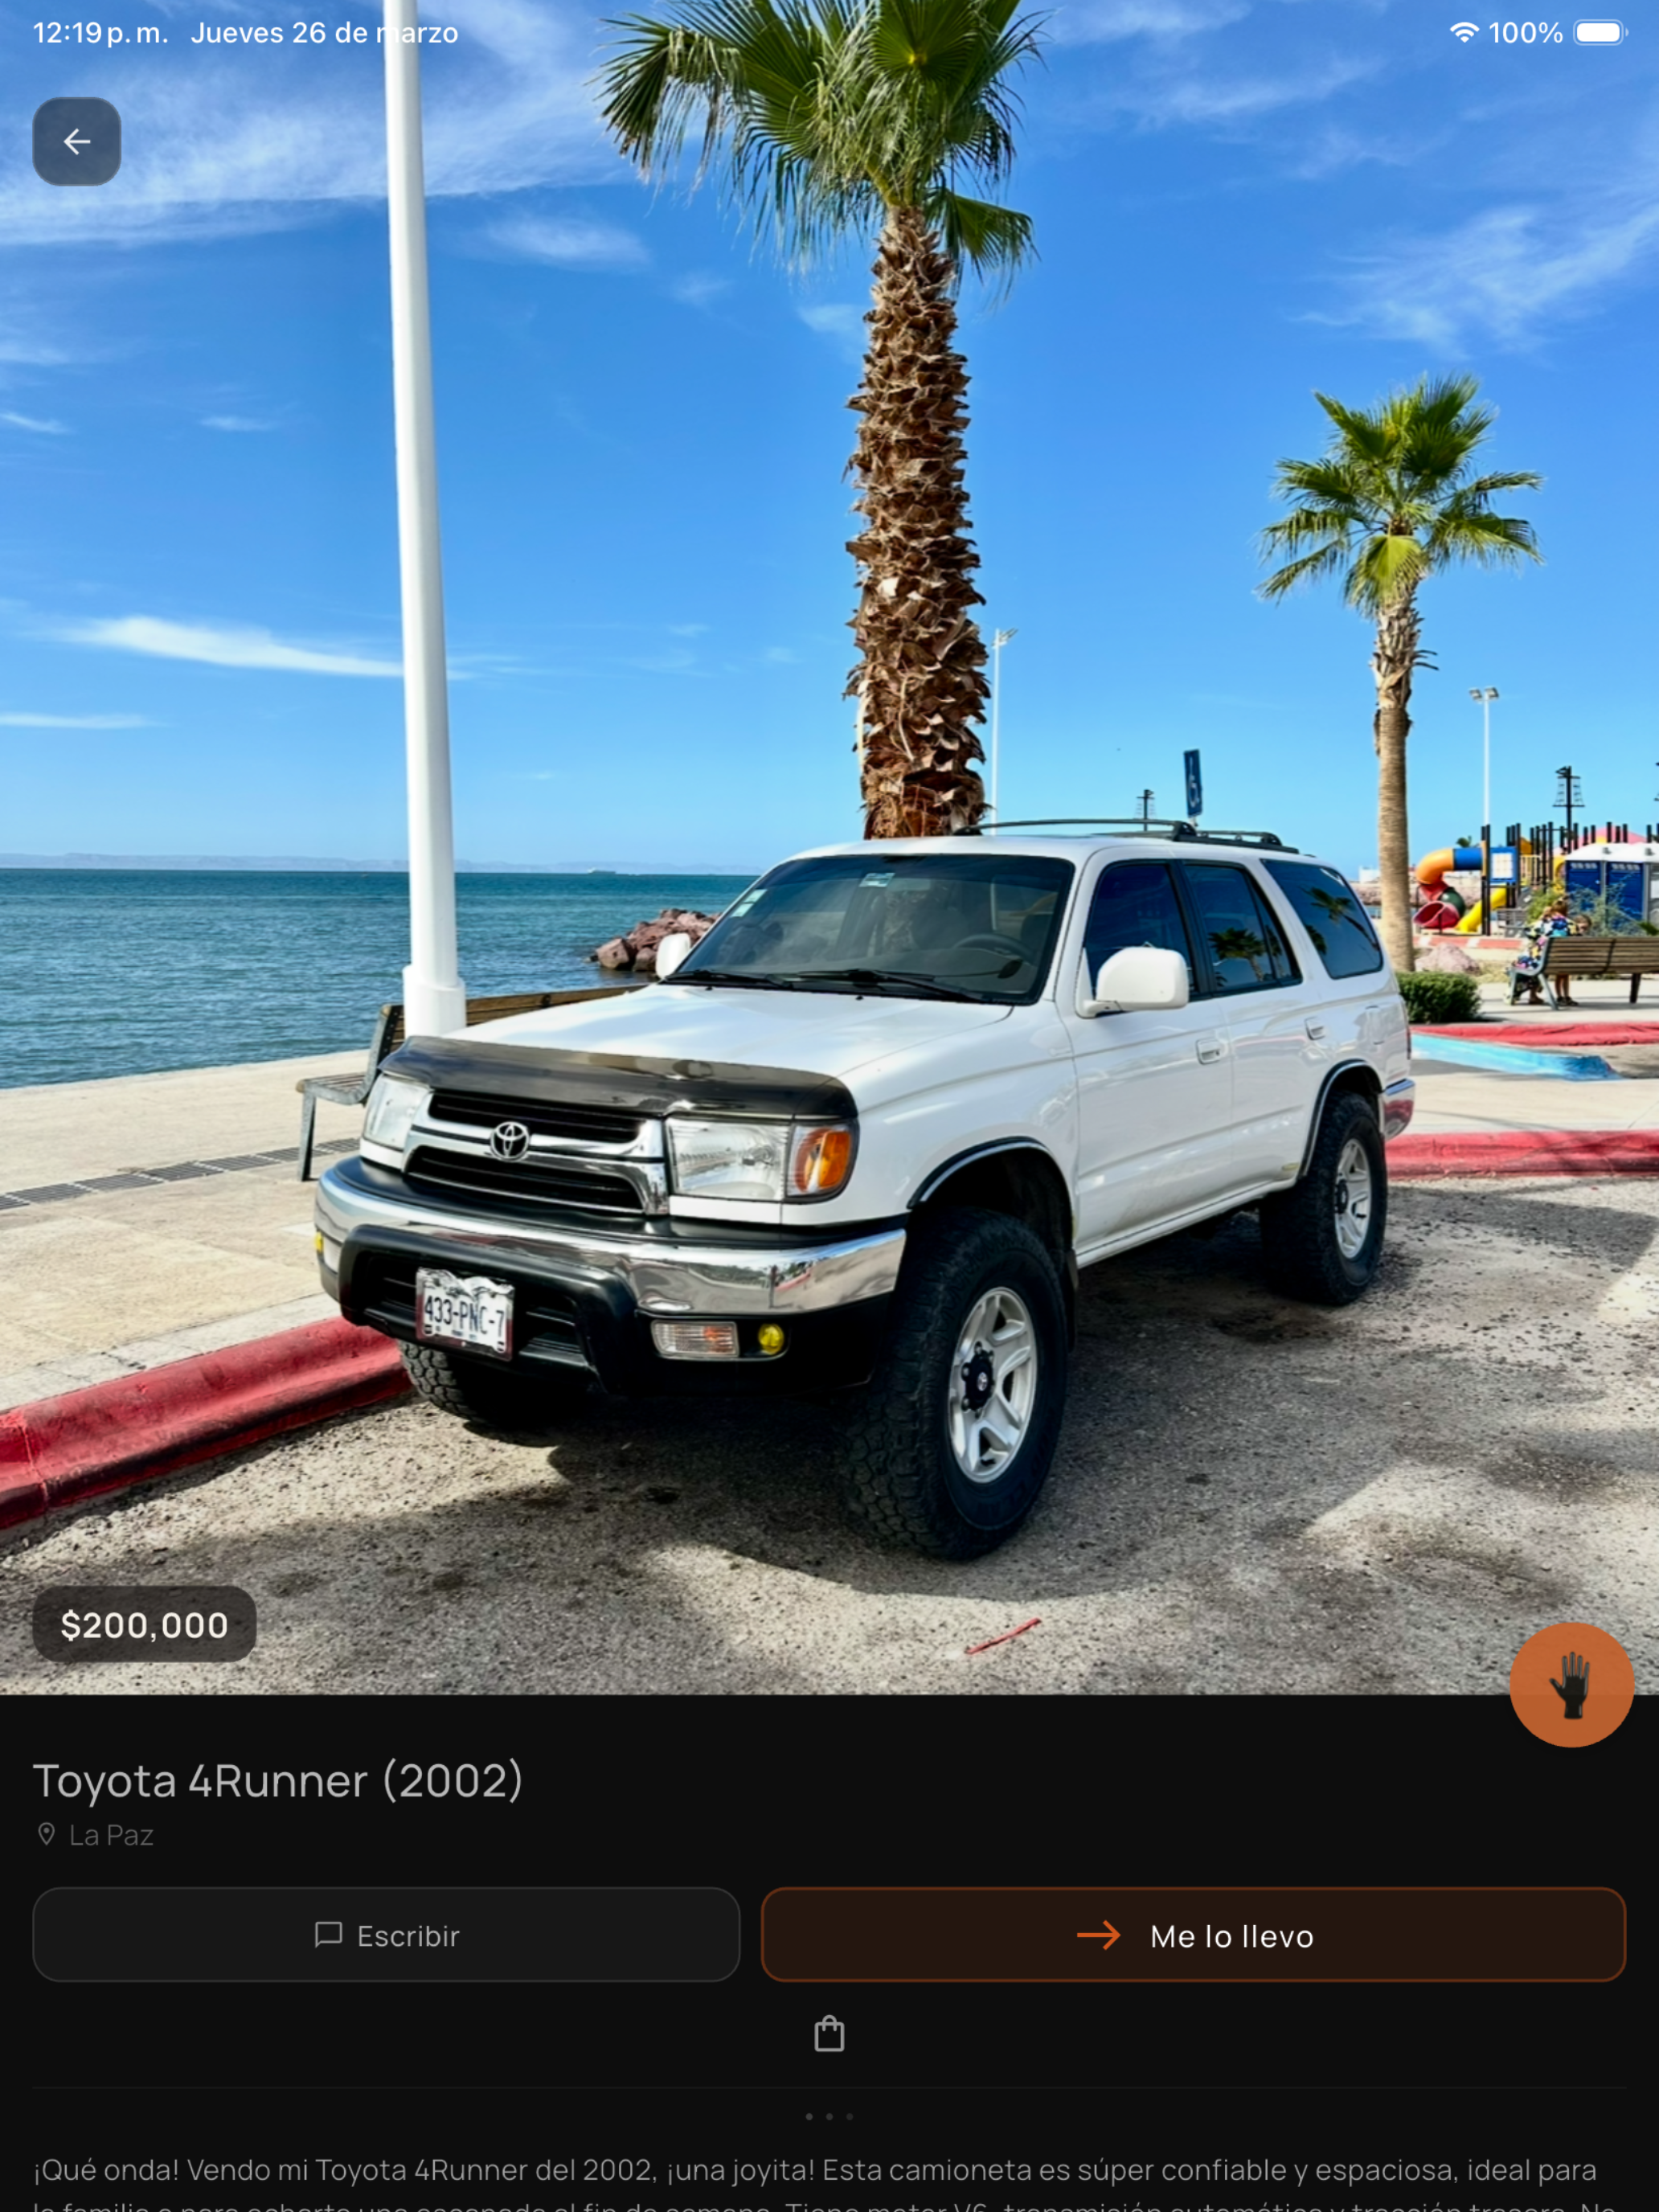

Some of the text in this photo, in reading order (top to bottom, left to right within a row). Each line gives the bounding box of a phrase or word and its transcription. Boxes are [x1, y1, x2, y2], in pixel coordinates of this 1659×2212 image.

[33, 22, 102, 43] 12:19
[190, 21, 459, 43] Jueves 26 de marzo
[1489, 22, 1563, 44] 100%
[424, 1294, 505, 1338] 433-PNC-7
[60, 1609, 228, 1642] $200,000
[32, 1757, 522, 1809] Toyota 4Runner (2002)
[71, 1824, 154, 1846] La Paz
[358, 1925, 461, 1948] Escribir
[1152, 1924, 1314, 1948] Me lo llevo
[35, 2157, 1596, 2188] ¡Qué onda! Vendo mi Toyota 4Runner del 2002, ¡una joyita! Esta camioneta es súper confiable y espaciosa, ideal para
